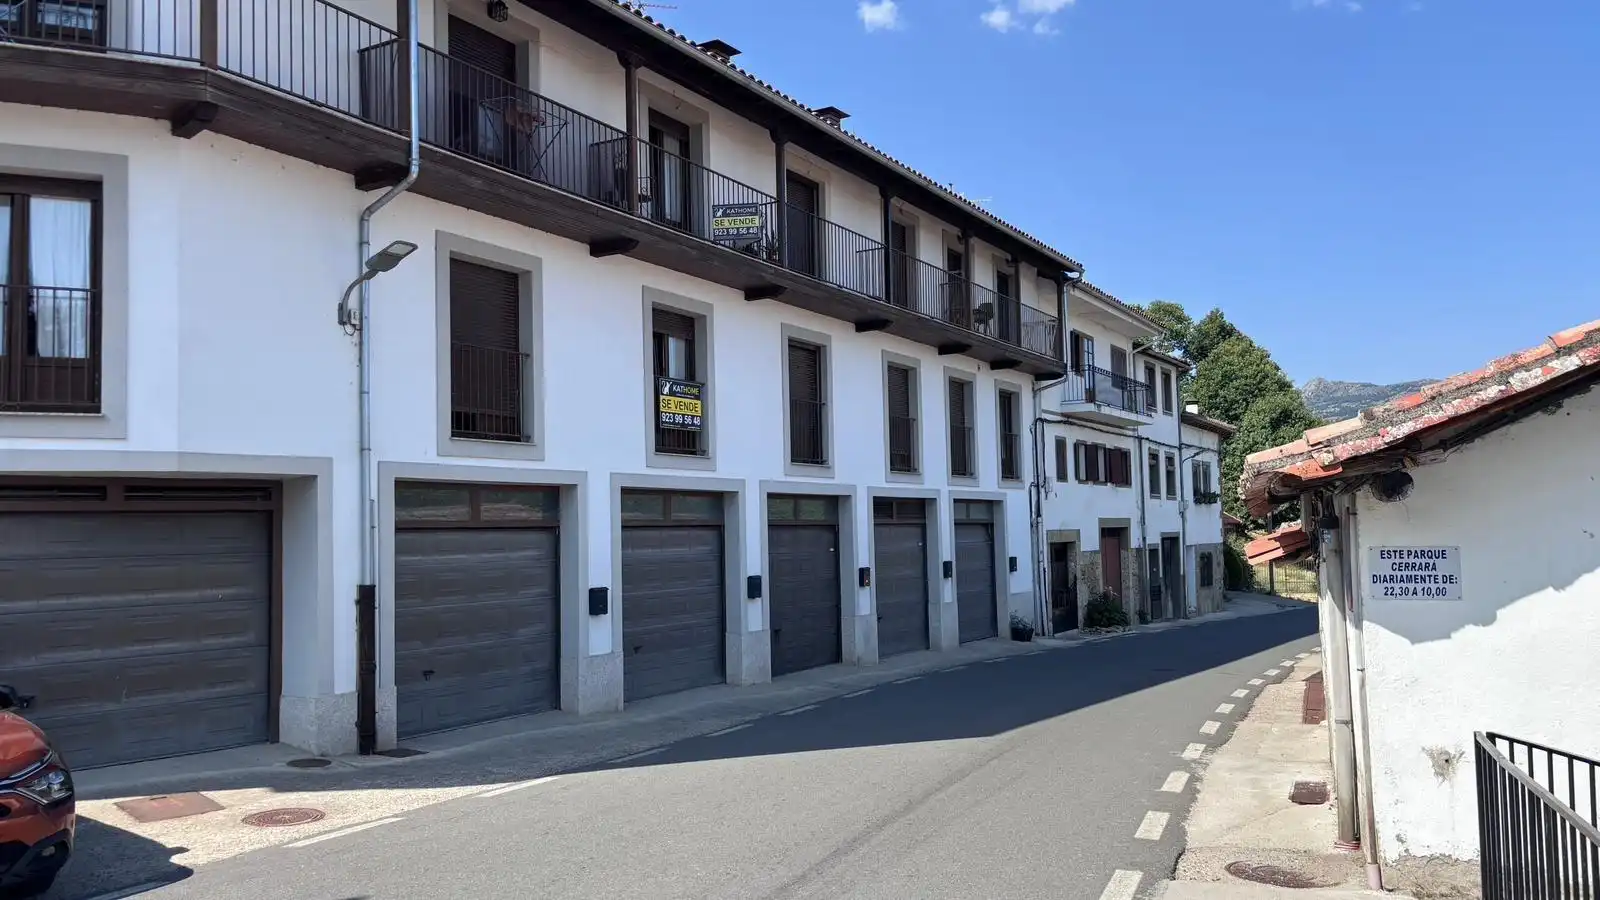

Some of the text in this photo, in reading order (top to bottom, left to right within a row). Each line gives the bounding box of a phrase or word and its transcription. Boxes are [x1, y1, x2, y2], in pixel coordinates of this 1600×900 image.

[714, 217, 757, 227] SE VENDE
[714, 228, 727, 236] 923
[672, 384, 700, 396] KATHOME
[661, 398, 699, 412] SE VENDE
[661, 412, 701, 426] 923 99 56 48
[1380, 549, 1447, 560] ESTE PARQUE
[1391, 559, 1437, 572] CERRARÁ
[1372, 574, 1458, 584] DIARIAMENTE DE:
[1383, 586, 1447, 598] 22,30 A 10,00
